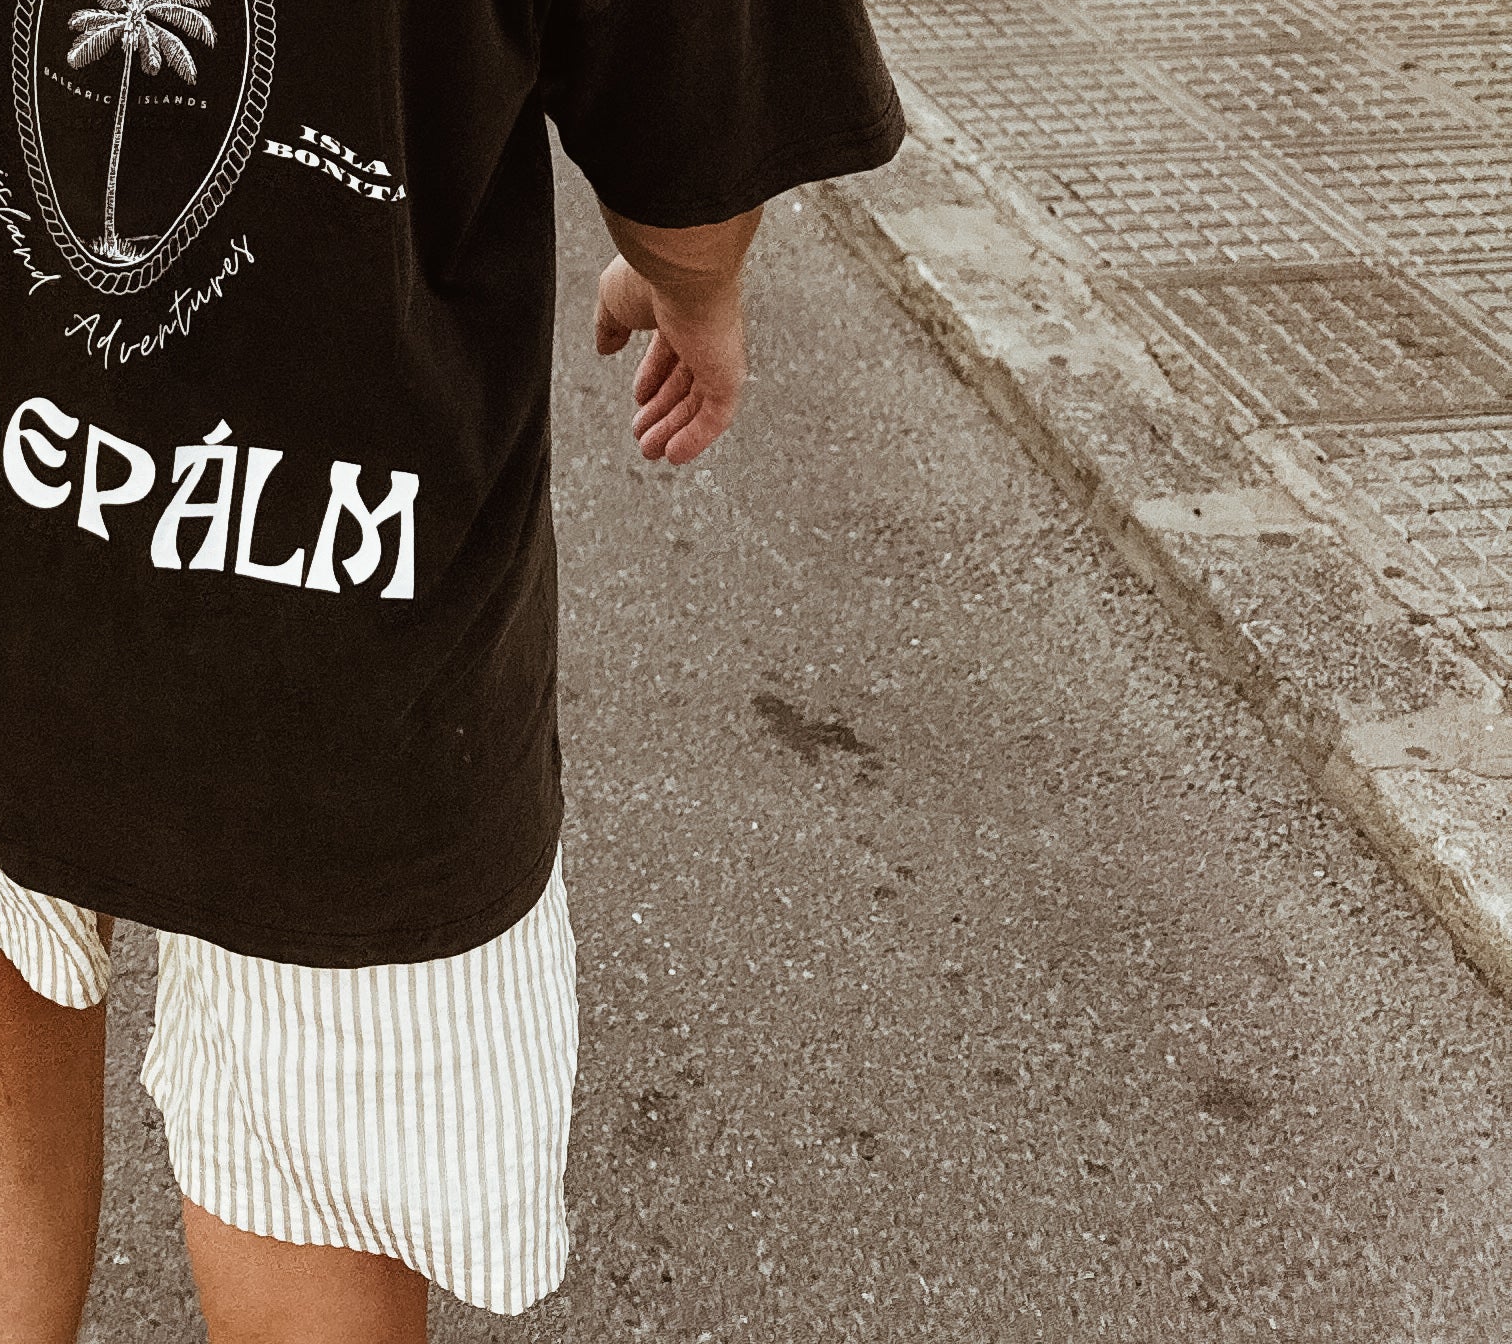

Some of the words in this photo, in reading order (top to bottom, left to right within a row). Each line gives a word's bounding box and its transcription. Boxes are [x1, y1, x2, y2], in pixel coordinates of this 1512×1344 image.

[43, 66, 112, 104] BALEARIC
[138, 94, 207, 109] ISLANDS
[262, 138, 407, 202] BONITA
[299, 124, 392, 177] ISLA
[64, 233, 255, 370] Adventures
